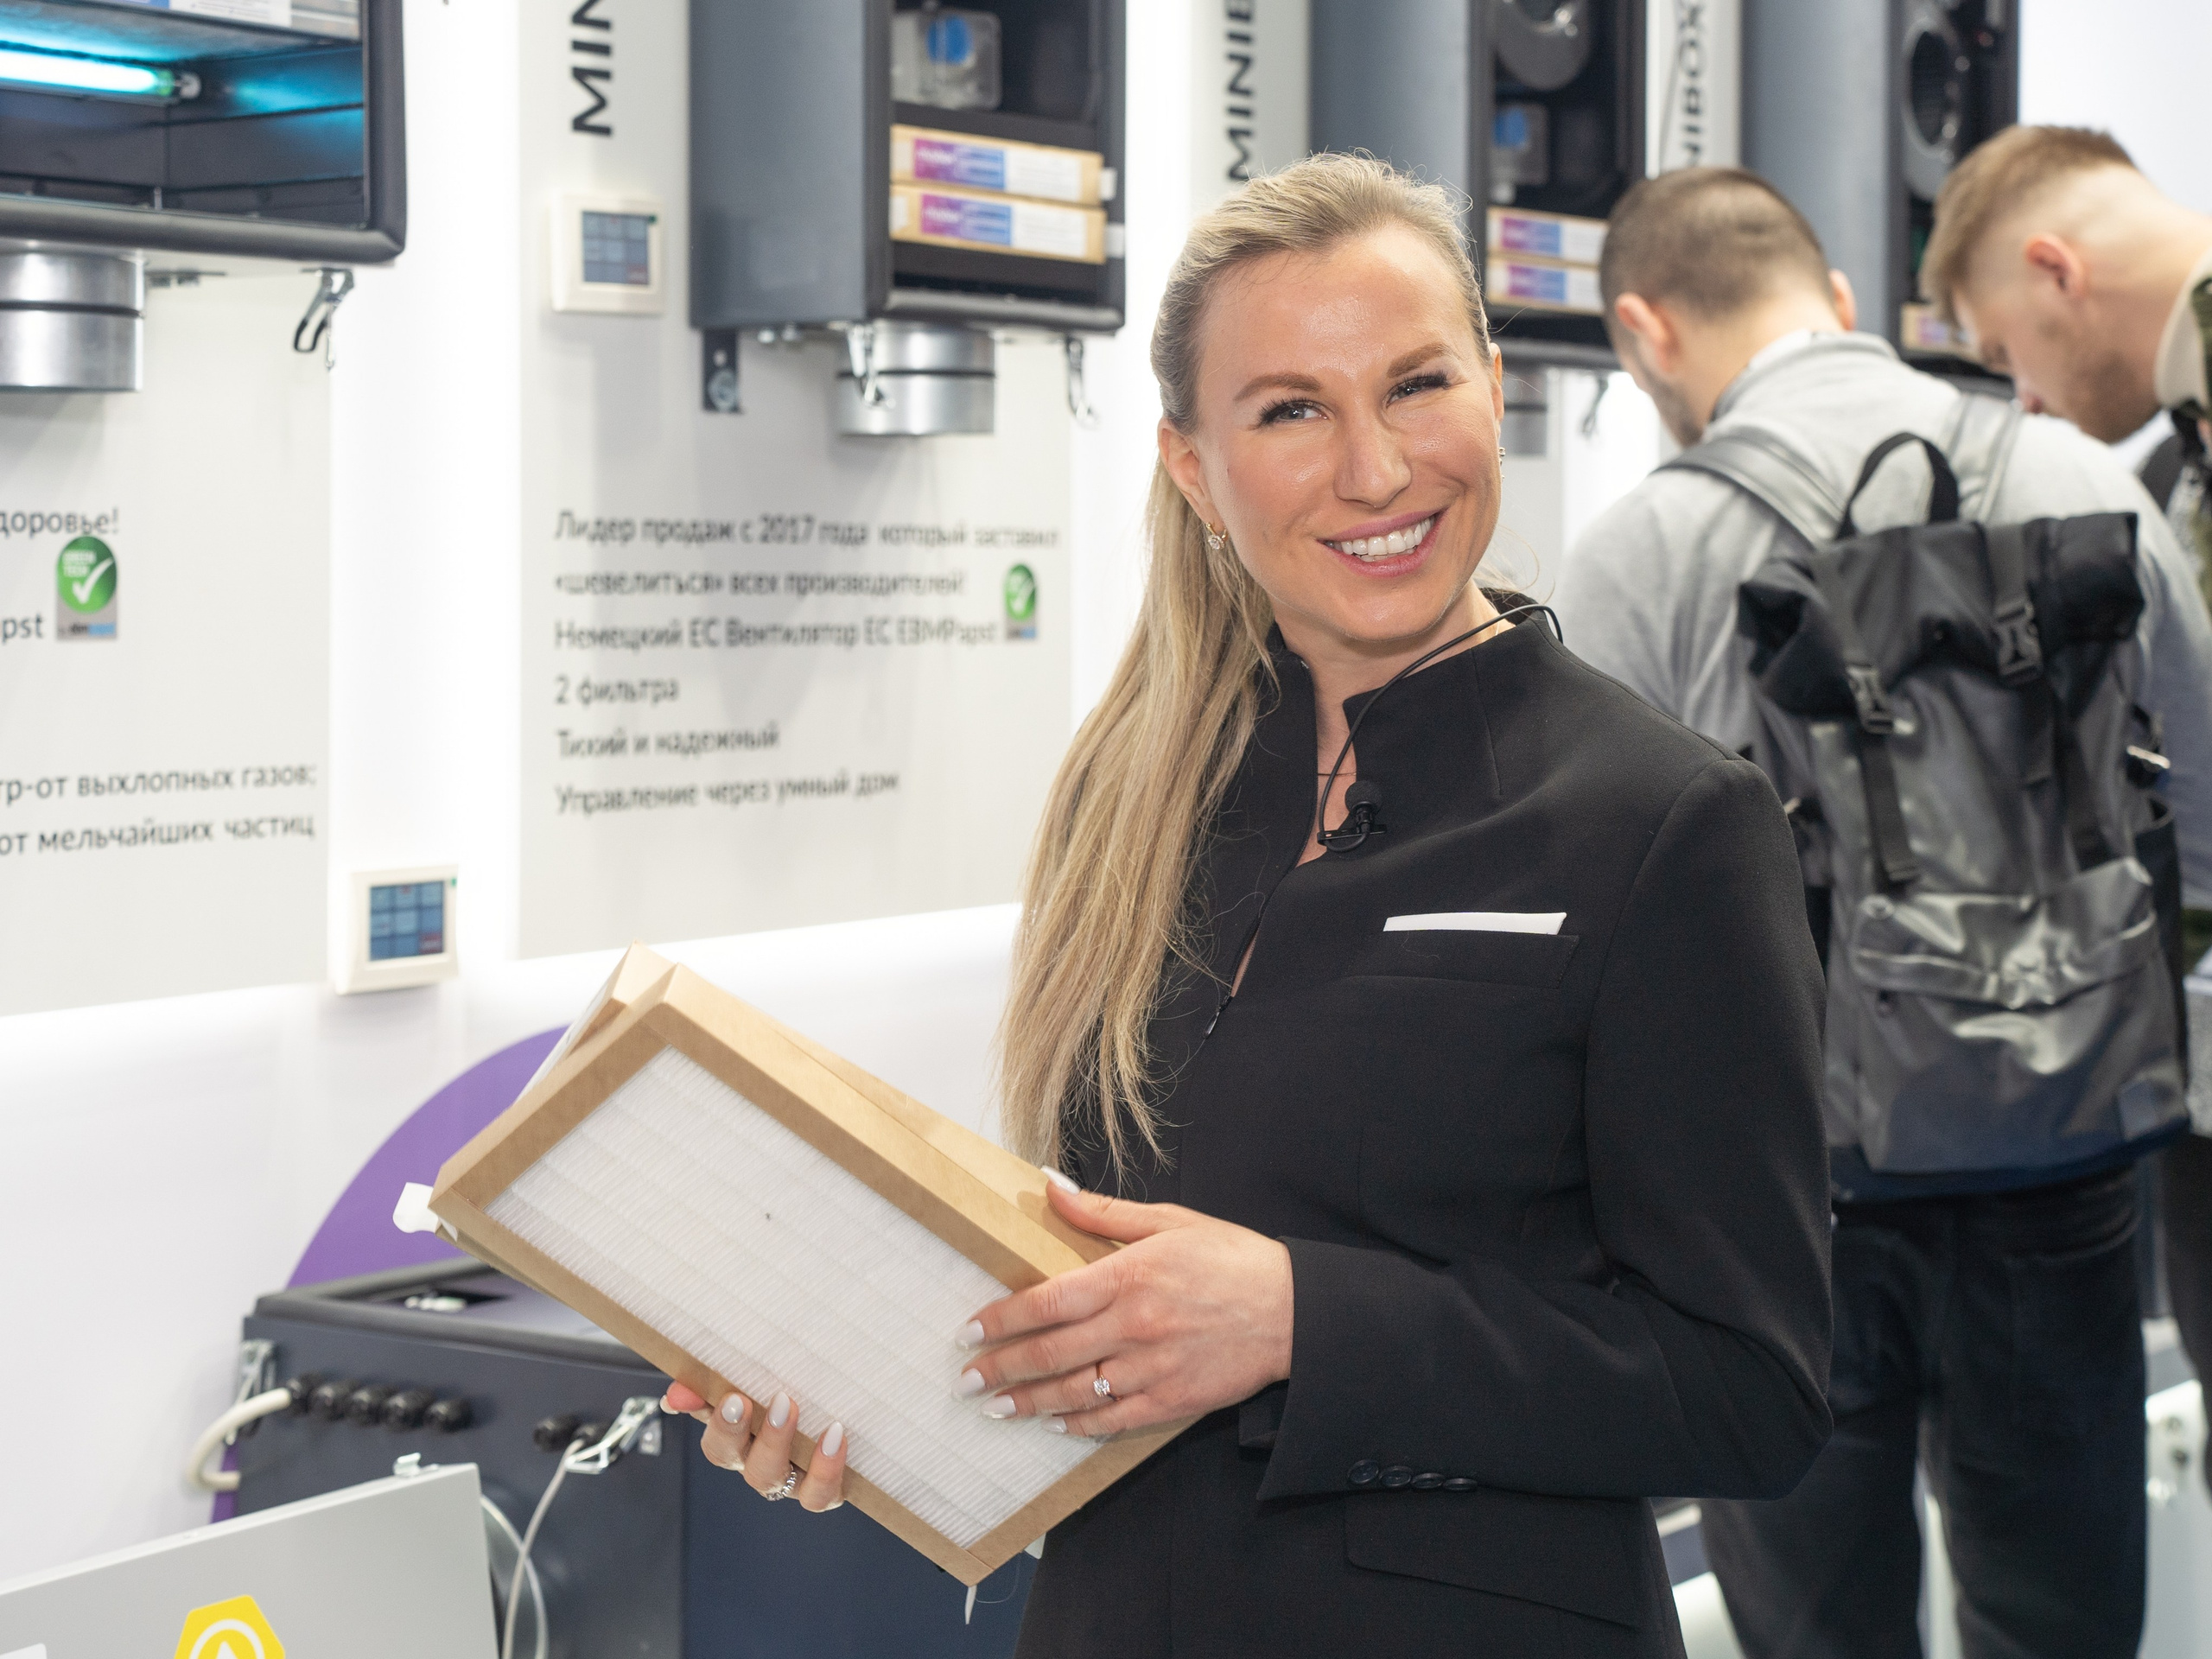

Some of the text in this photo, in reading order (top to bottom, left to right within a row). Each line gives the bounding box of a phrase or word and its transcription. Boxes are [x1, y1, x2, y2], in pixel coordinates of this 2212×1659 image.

[555, 510, 636, 547] Лидер
[640, 517, 733, 549] продаж
[740, 521, 755, 543] с
[760, 514, 815, 544] 2017
[880, 520, 968, 550] который
[974, 526, 1060, 548] заставил
[556, 567, 966, 599] «шевелиться» всех производителей
[2, 613, 44, 645] pst
[555, 617, 683, 654] Немецкий
[726, 616, 857, 652] Вентилятор
[556, 674, 679, 709] 2 фильтра
[556, 719, 779, 760] Тихий и надежный
[0, 776, 67, 807] р-от
[78, 770, 234, 797] выхлопных
[554, 766, 900, 818] Управление через умный дом
[0, 815, 316, 855] от мельчайших частиц
